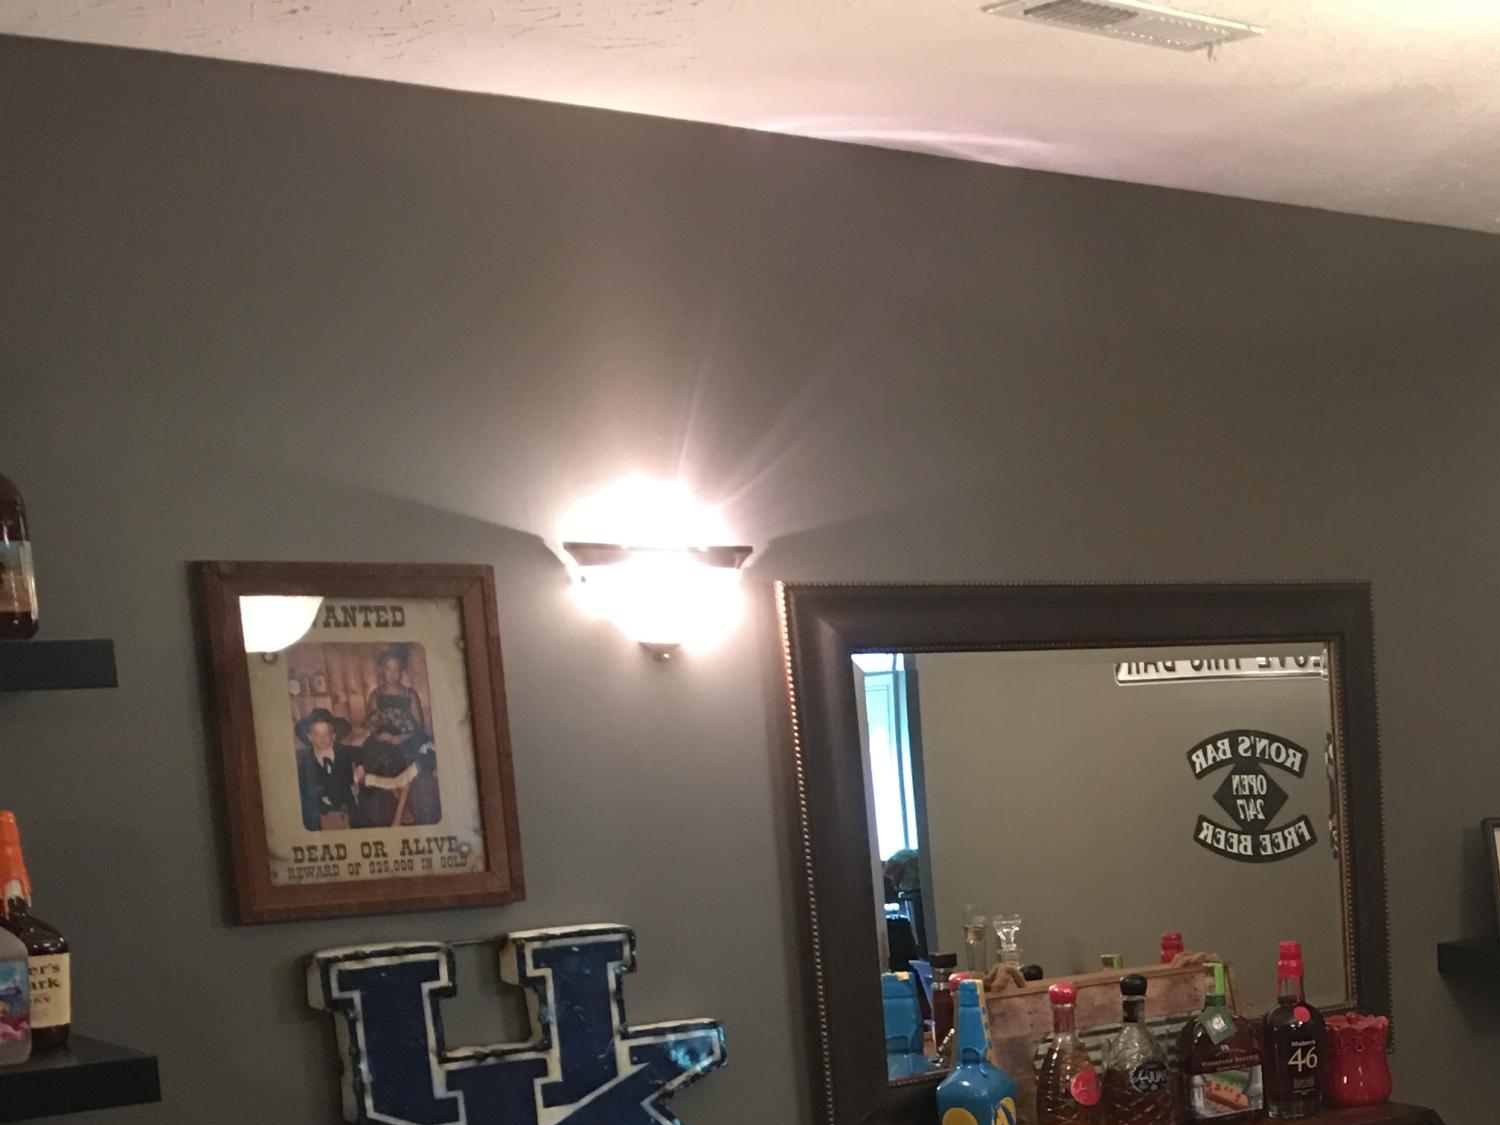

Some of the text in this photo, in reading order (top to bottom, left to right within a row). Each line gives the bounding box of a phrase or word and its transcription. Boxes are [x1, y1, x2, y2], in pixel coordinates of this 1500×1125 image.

[312, 604, 406, 628] ANTED
[291, 835, 459, 864] DEAD OR ALIVE
[29, 963, 61, 976] er's
[1287, 1046, 1319, 1073] 46
